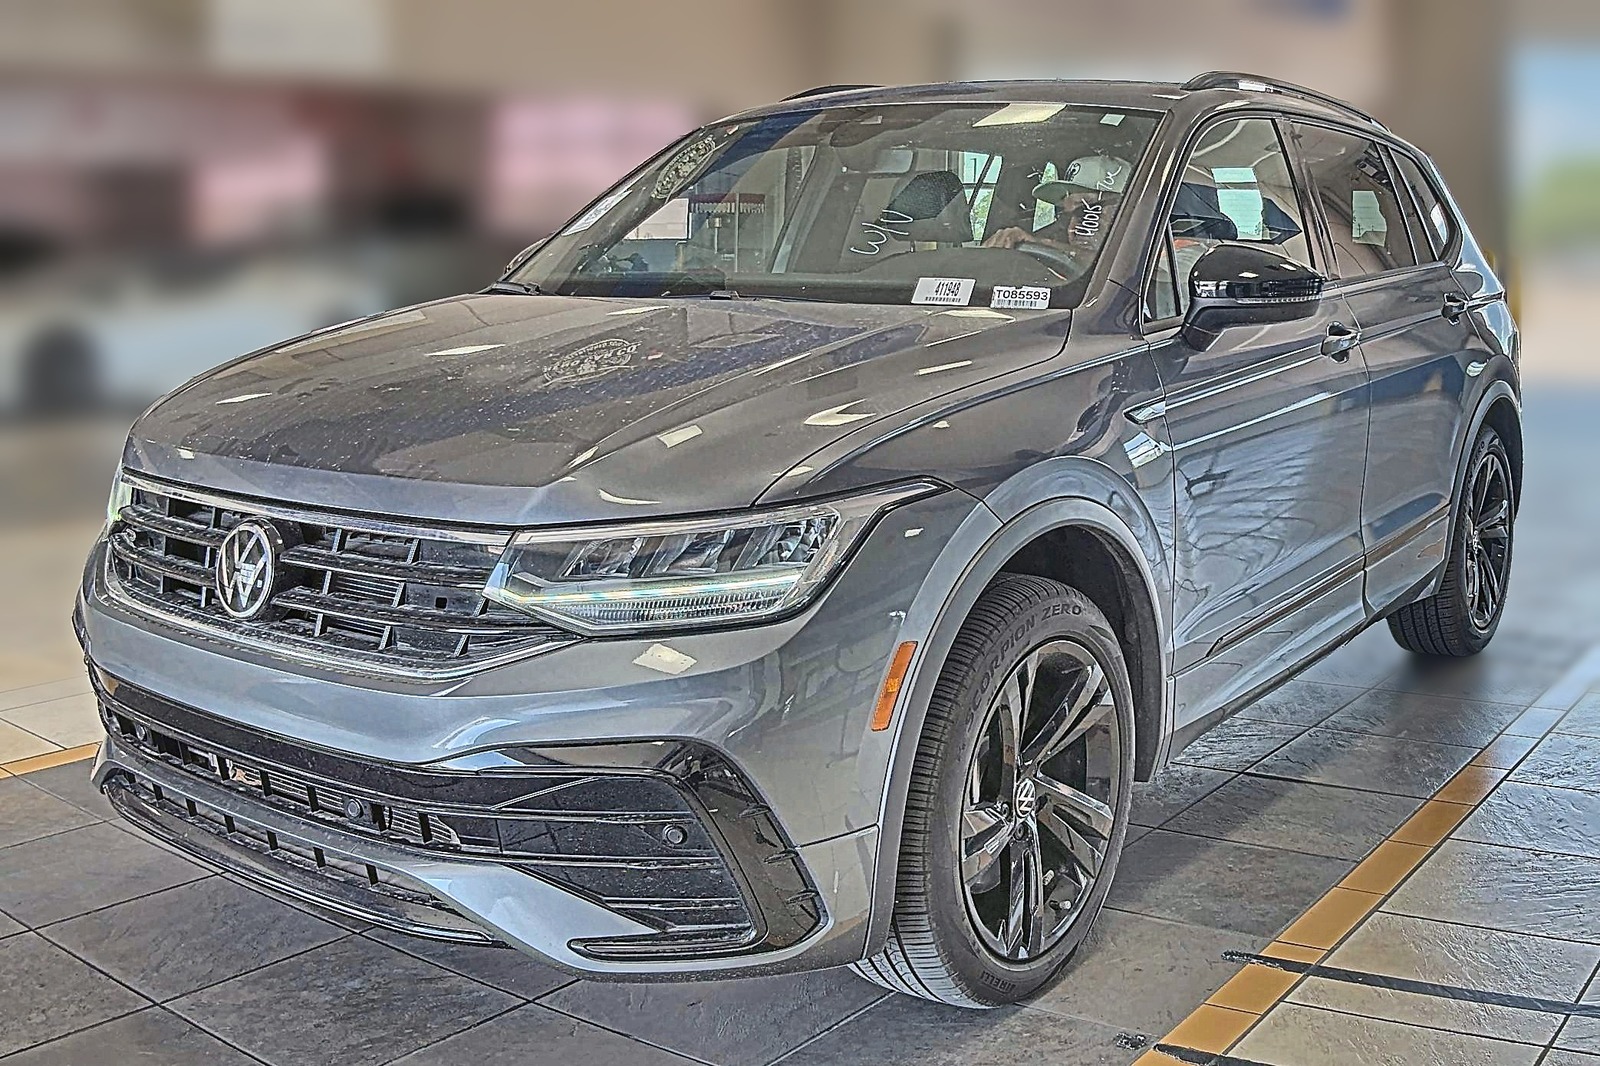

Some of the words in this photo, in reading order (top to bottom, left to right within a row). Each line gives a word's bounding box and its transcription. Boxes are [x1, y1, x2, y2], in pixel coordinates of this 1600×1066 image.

[934, 281, 961, 297] 411948
[217, 522, 273, 619] VW
[964, 615, 1036, 733] SCORPION
[1041, 603, 1082, 621] ZERO
